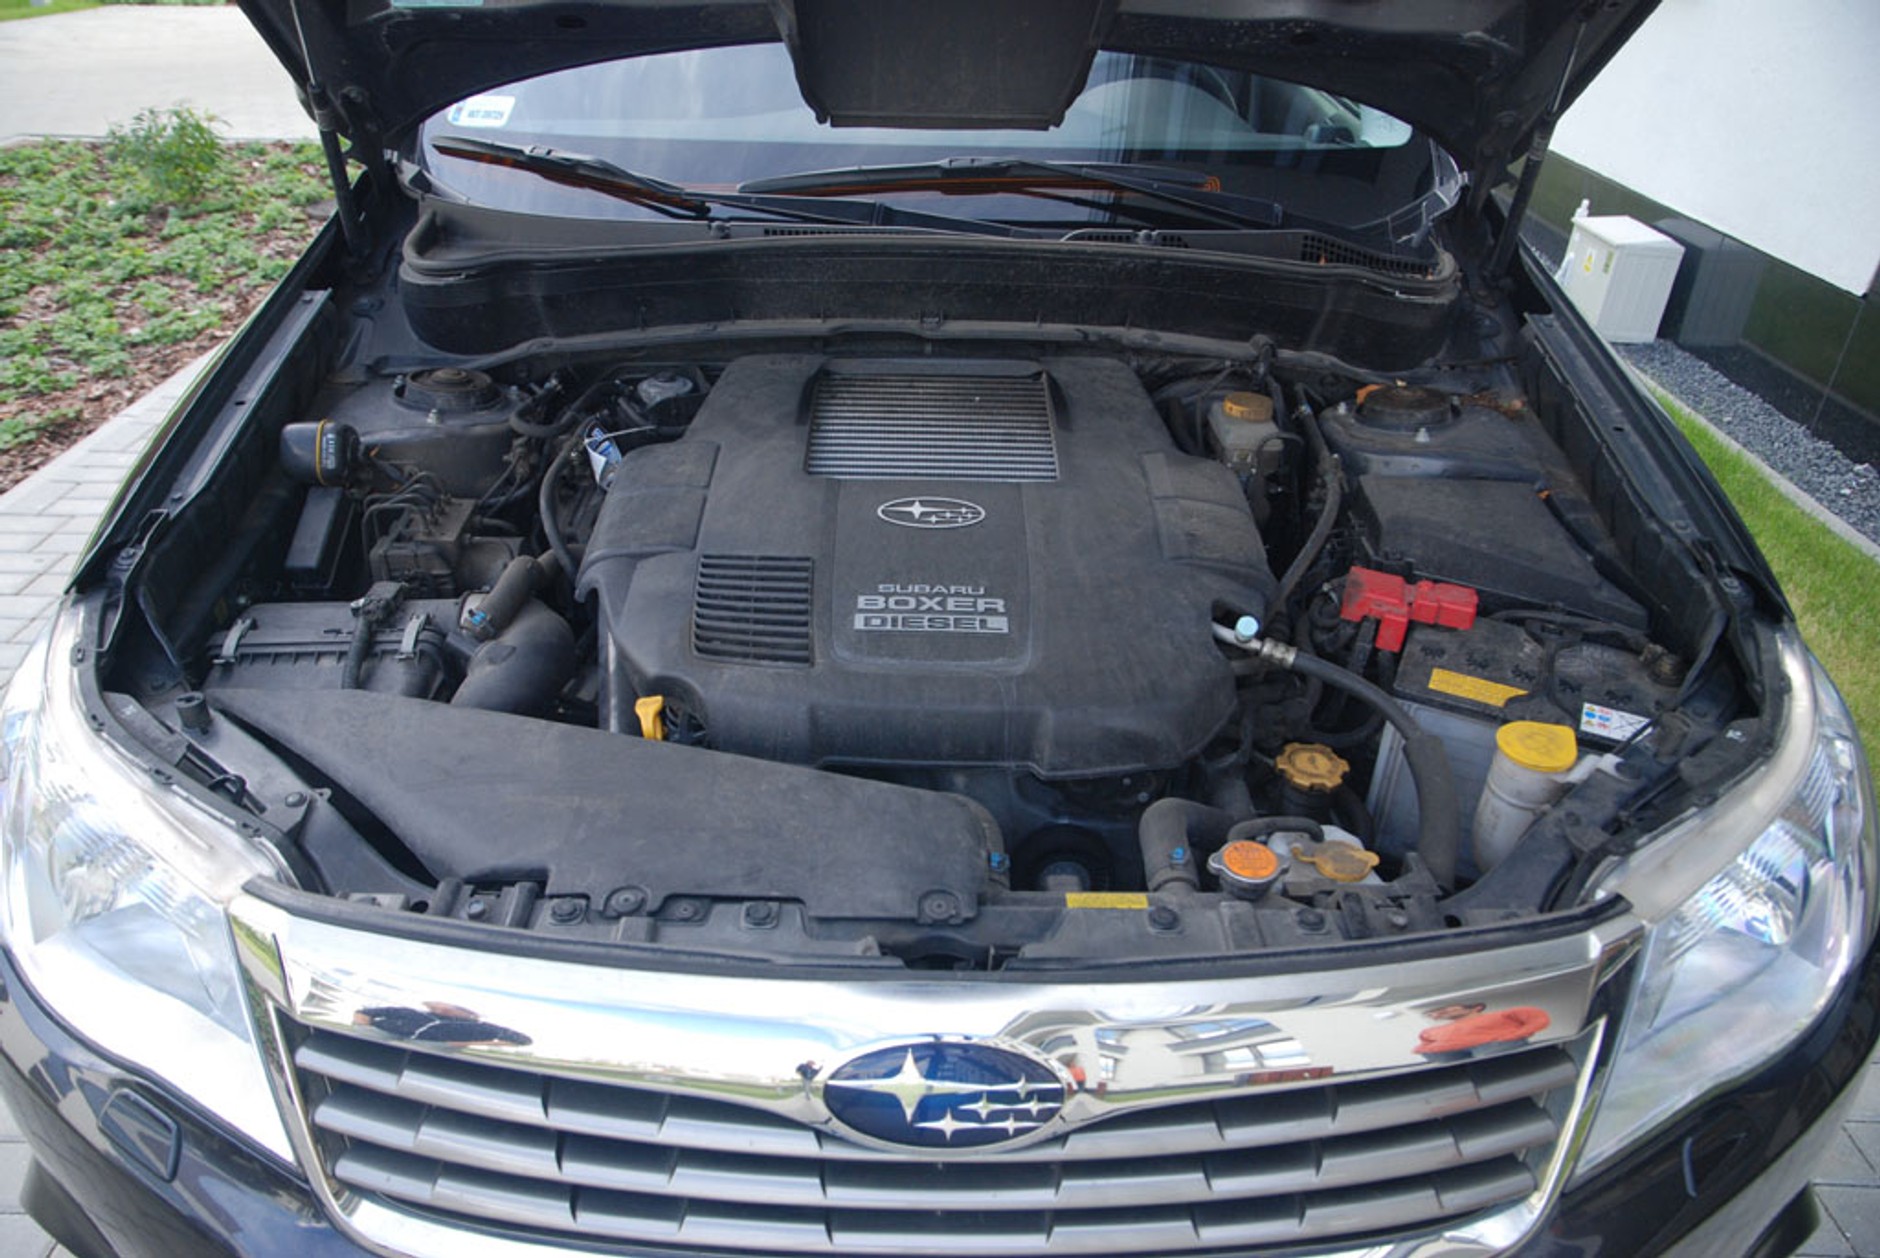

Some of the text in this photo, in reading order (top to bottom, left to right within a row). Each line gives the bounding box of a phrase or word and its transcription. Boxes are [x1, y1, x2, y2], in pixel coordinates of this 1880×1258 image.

[877, 583, 985, 595] SUBARU
[857, 595, 1006, 613] BOXER
[860, 614, 1006, 632] DIESEL
